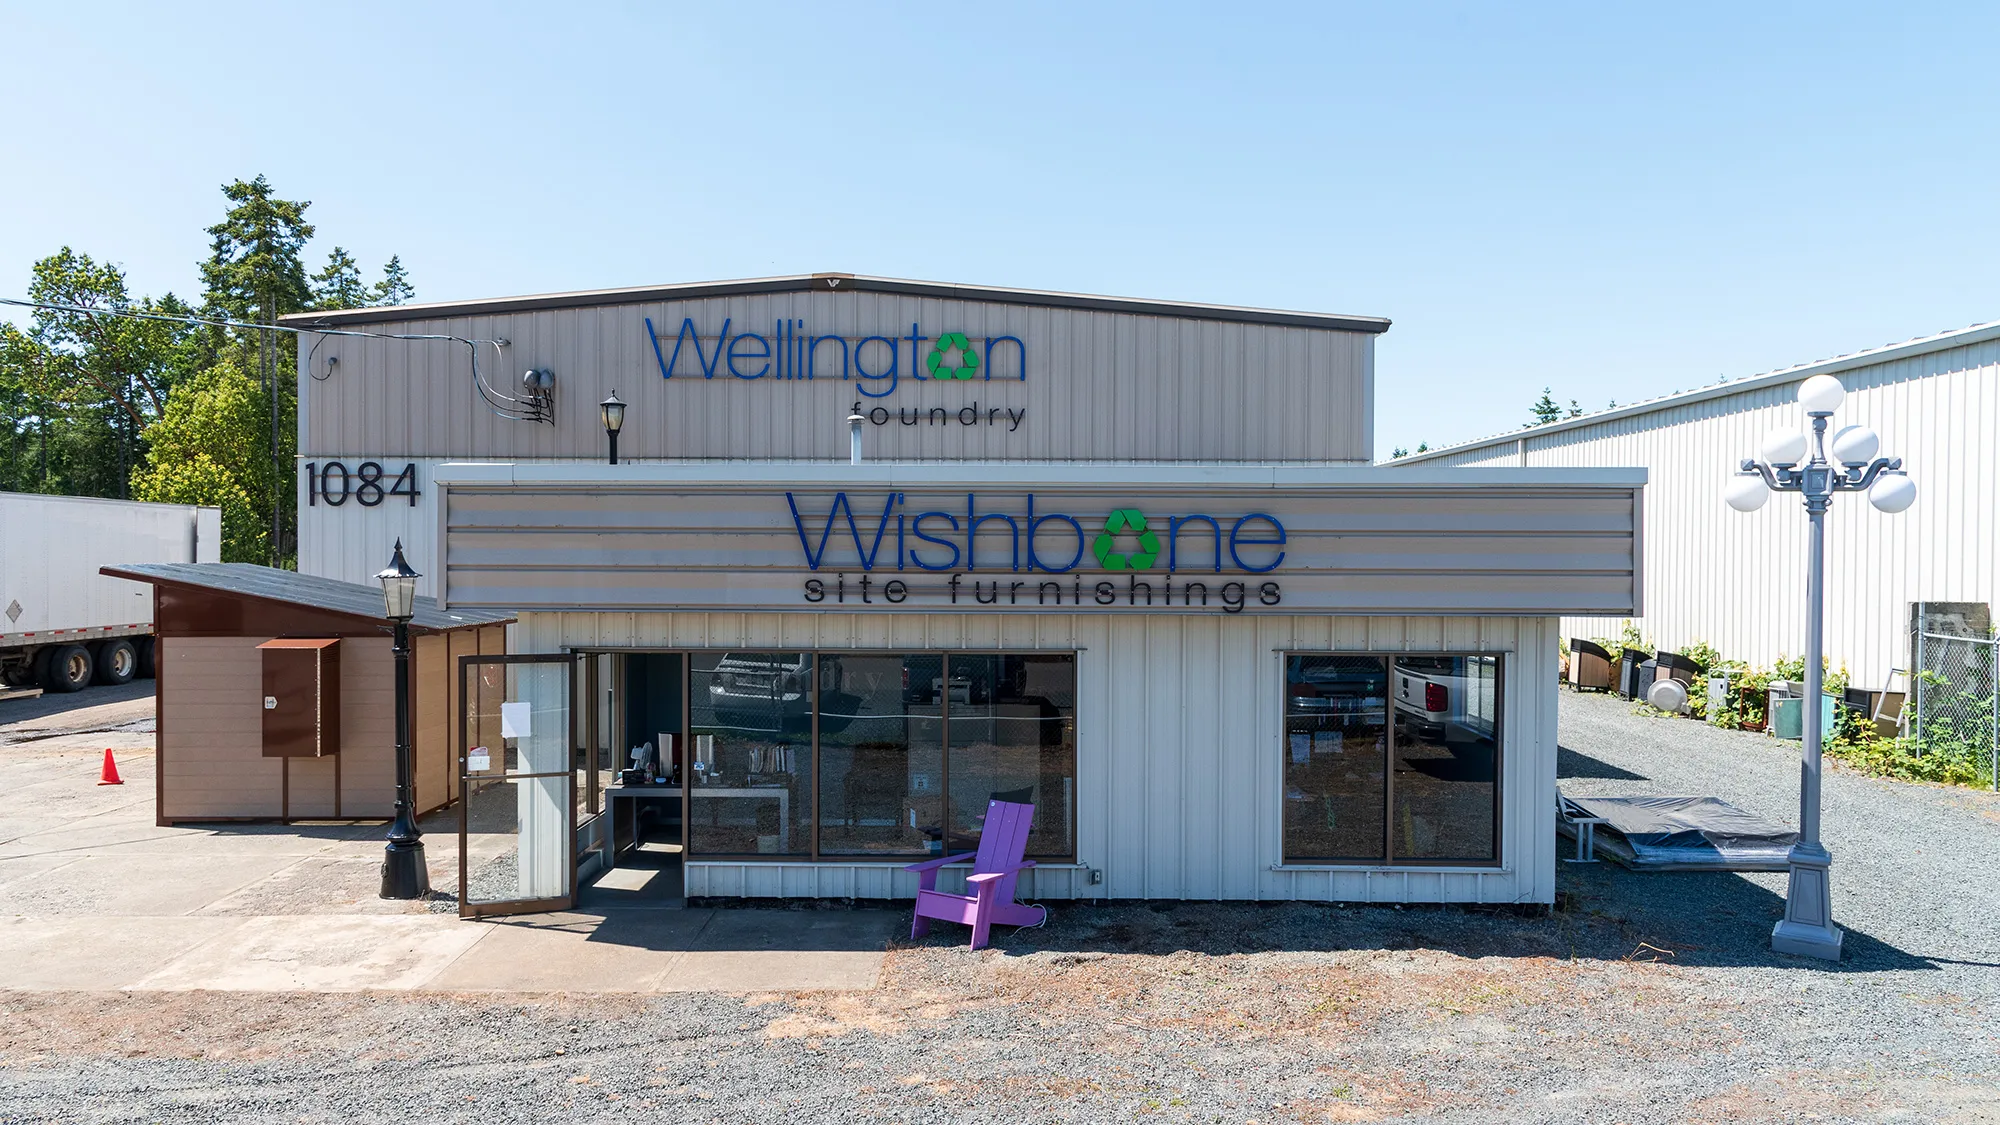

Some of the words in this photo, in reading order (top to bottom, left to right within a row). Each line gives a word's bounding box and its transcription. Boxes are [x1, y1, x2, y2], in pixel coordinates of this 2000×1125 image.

[851, 401, 1026, 432] foundry
[305, 461, 421, 507] 1084
[804, 573, 908, 603] site
[947, 573, 1282, 614] furnishings
